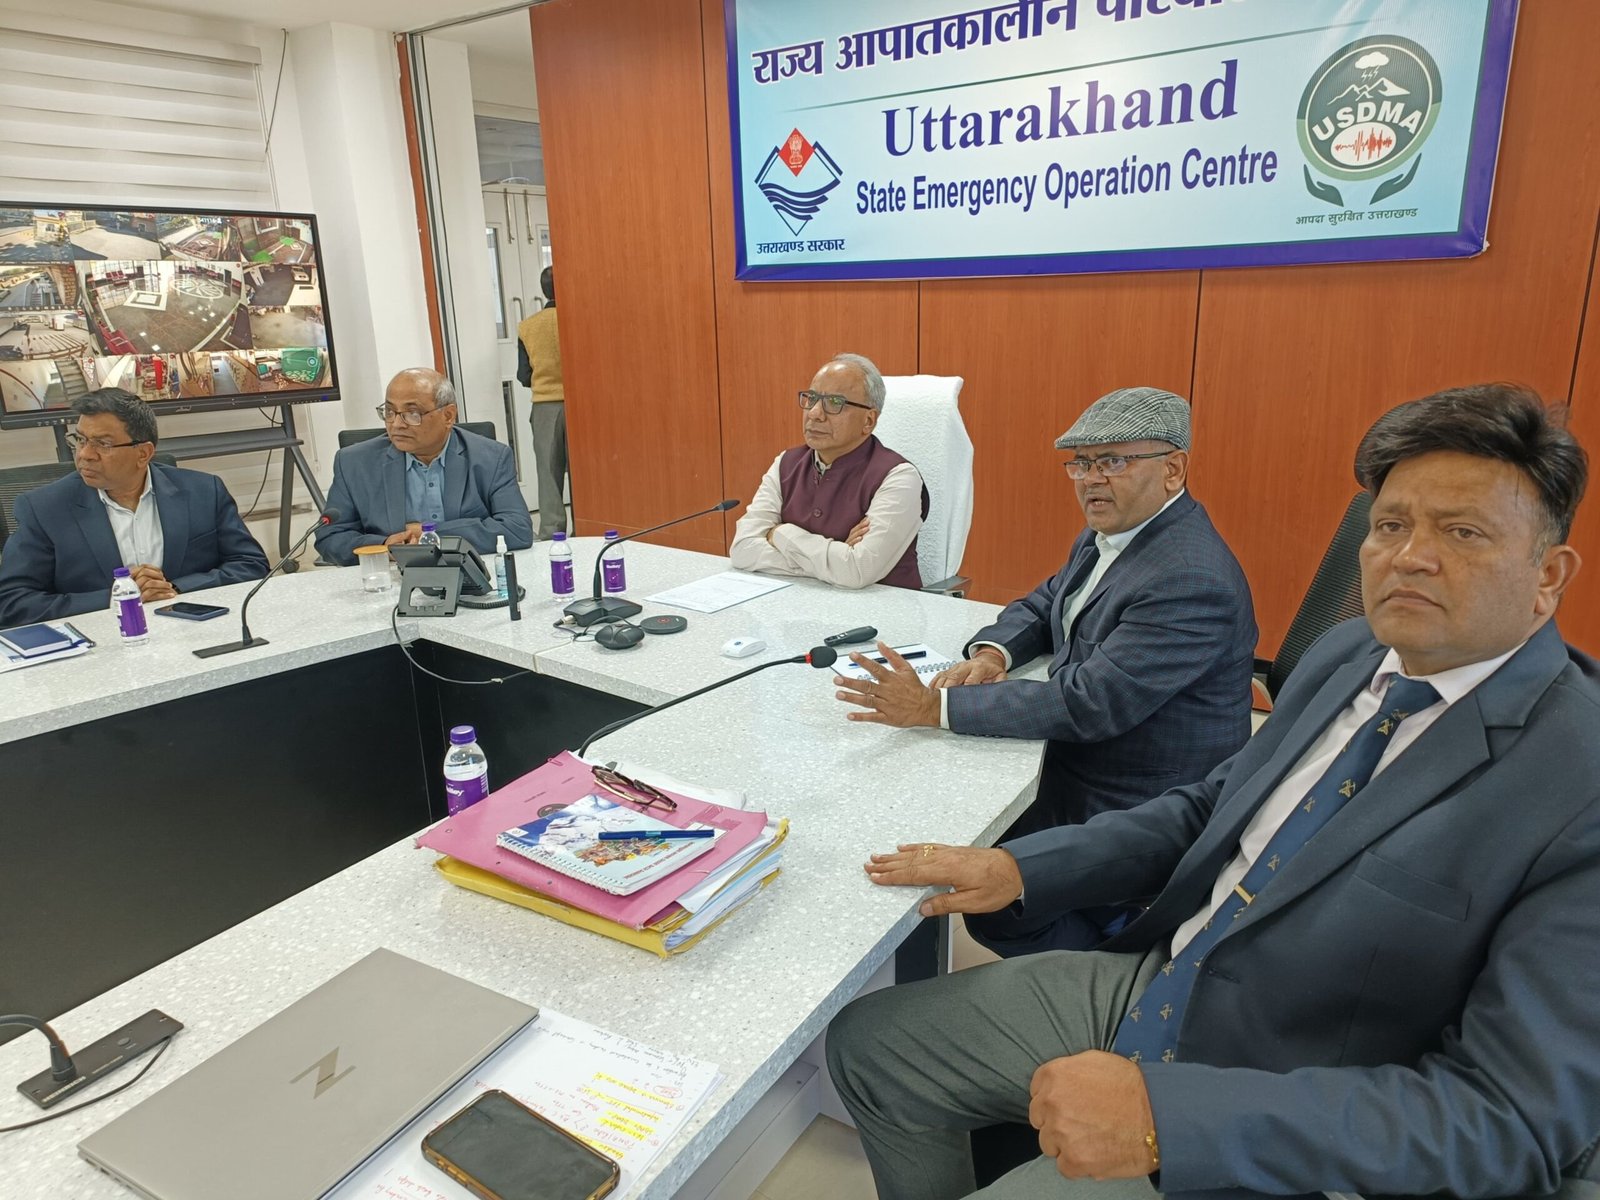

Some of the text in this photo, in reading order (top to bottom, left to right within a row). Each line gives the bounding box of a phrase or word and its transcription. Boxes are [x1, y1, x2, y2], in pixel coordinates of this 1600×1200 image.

[752, 40, 824, 84] राज्य
[882, 59, 1239, 157] Uttarakhand
[1311, 100, 1423, 141] USDMA
[856, 144, 1278, 216] State Emergency Operation Centre
[1295, 207, 1419, 226] आपदा सुरक्षित उत्तराखण्ड
[756, 238, 846, 254] उत्तराखण्ड सरकार
